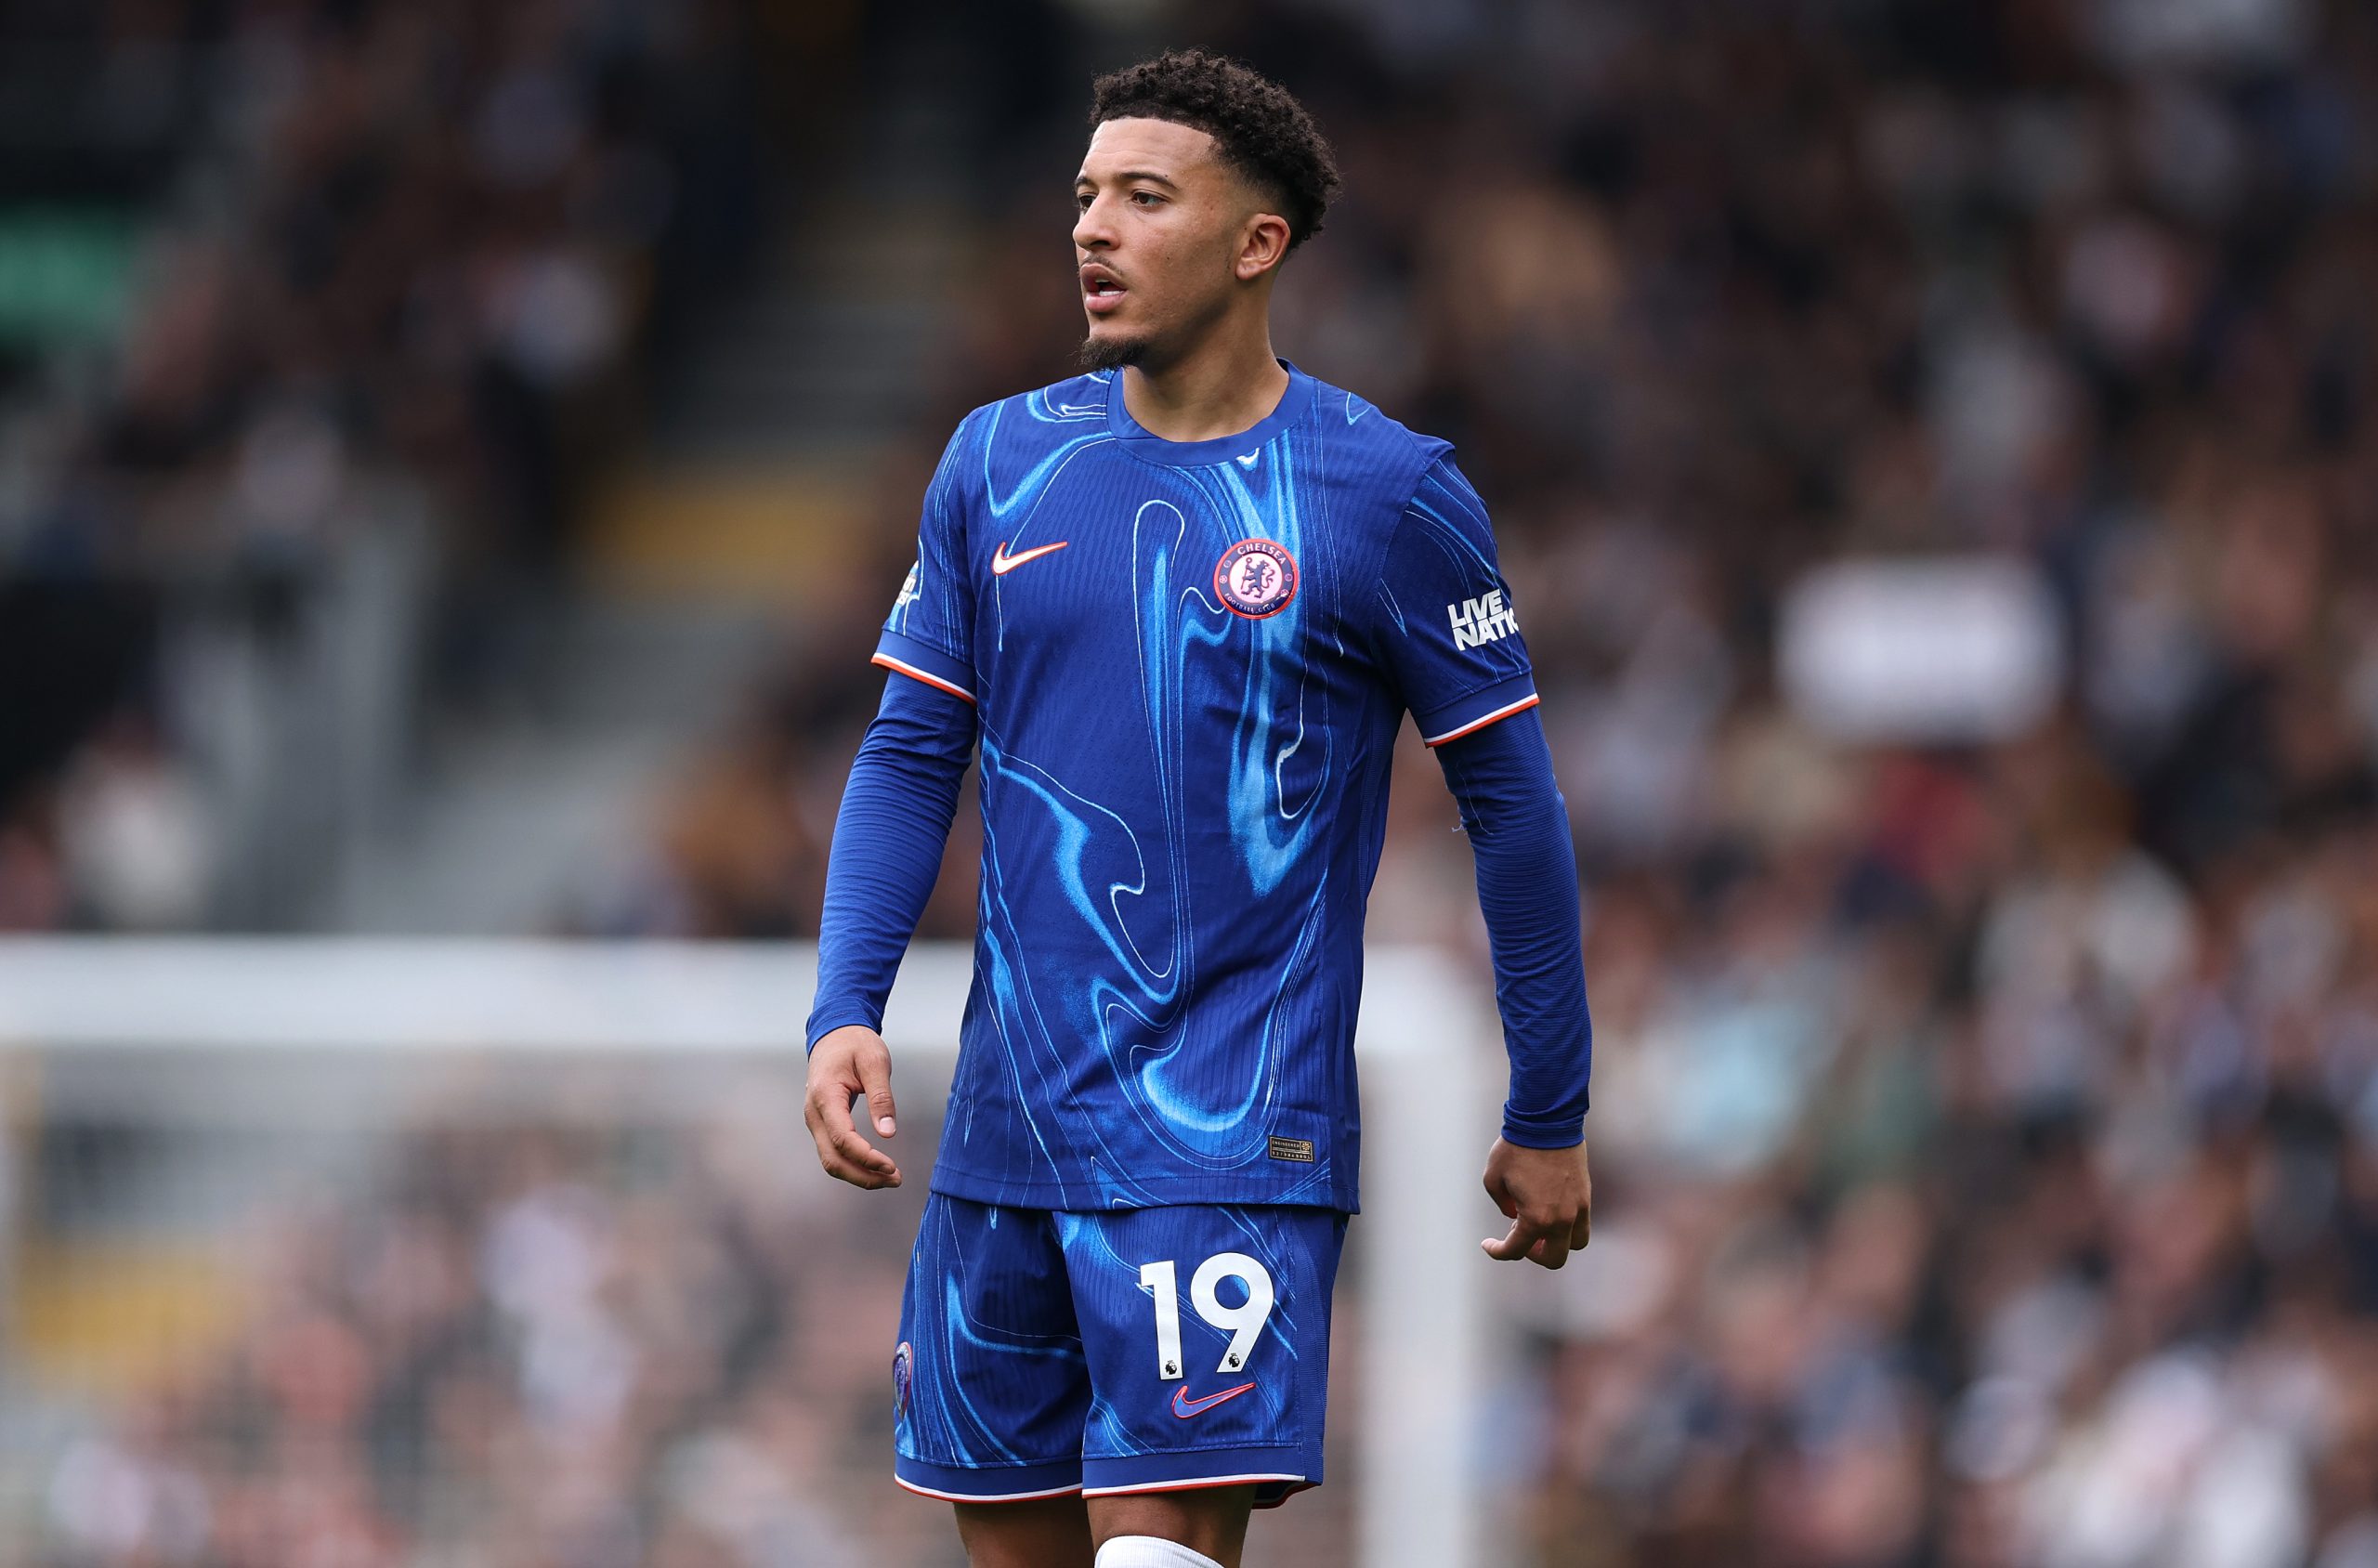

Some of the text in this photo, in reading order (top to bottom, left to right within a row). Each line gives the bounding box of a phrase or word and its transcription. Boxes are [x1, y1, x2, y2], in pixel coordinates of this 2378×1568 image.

[1236, 542, 1287, 565] CHELSEA
[1447, 588, 1503, 629] LIVE
[1140, 1252, 1274, 1380] 19
